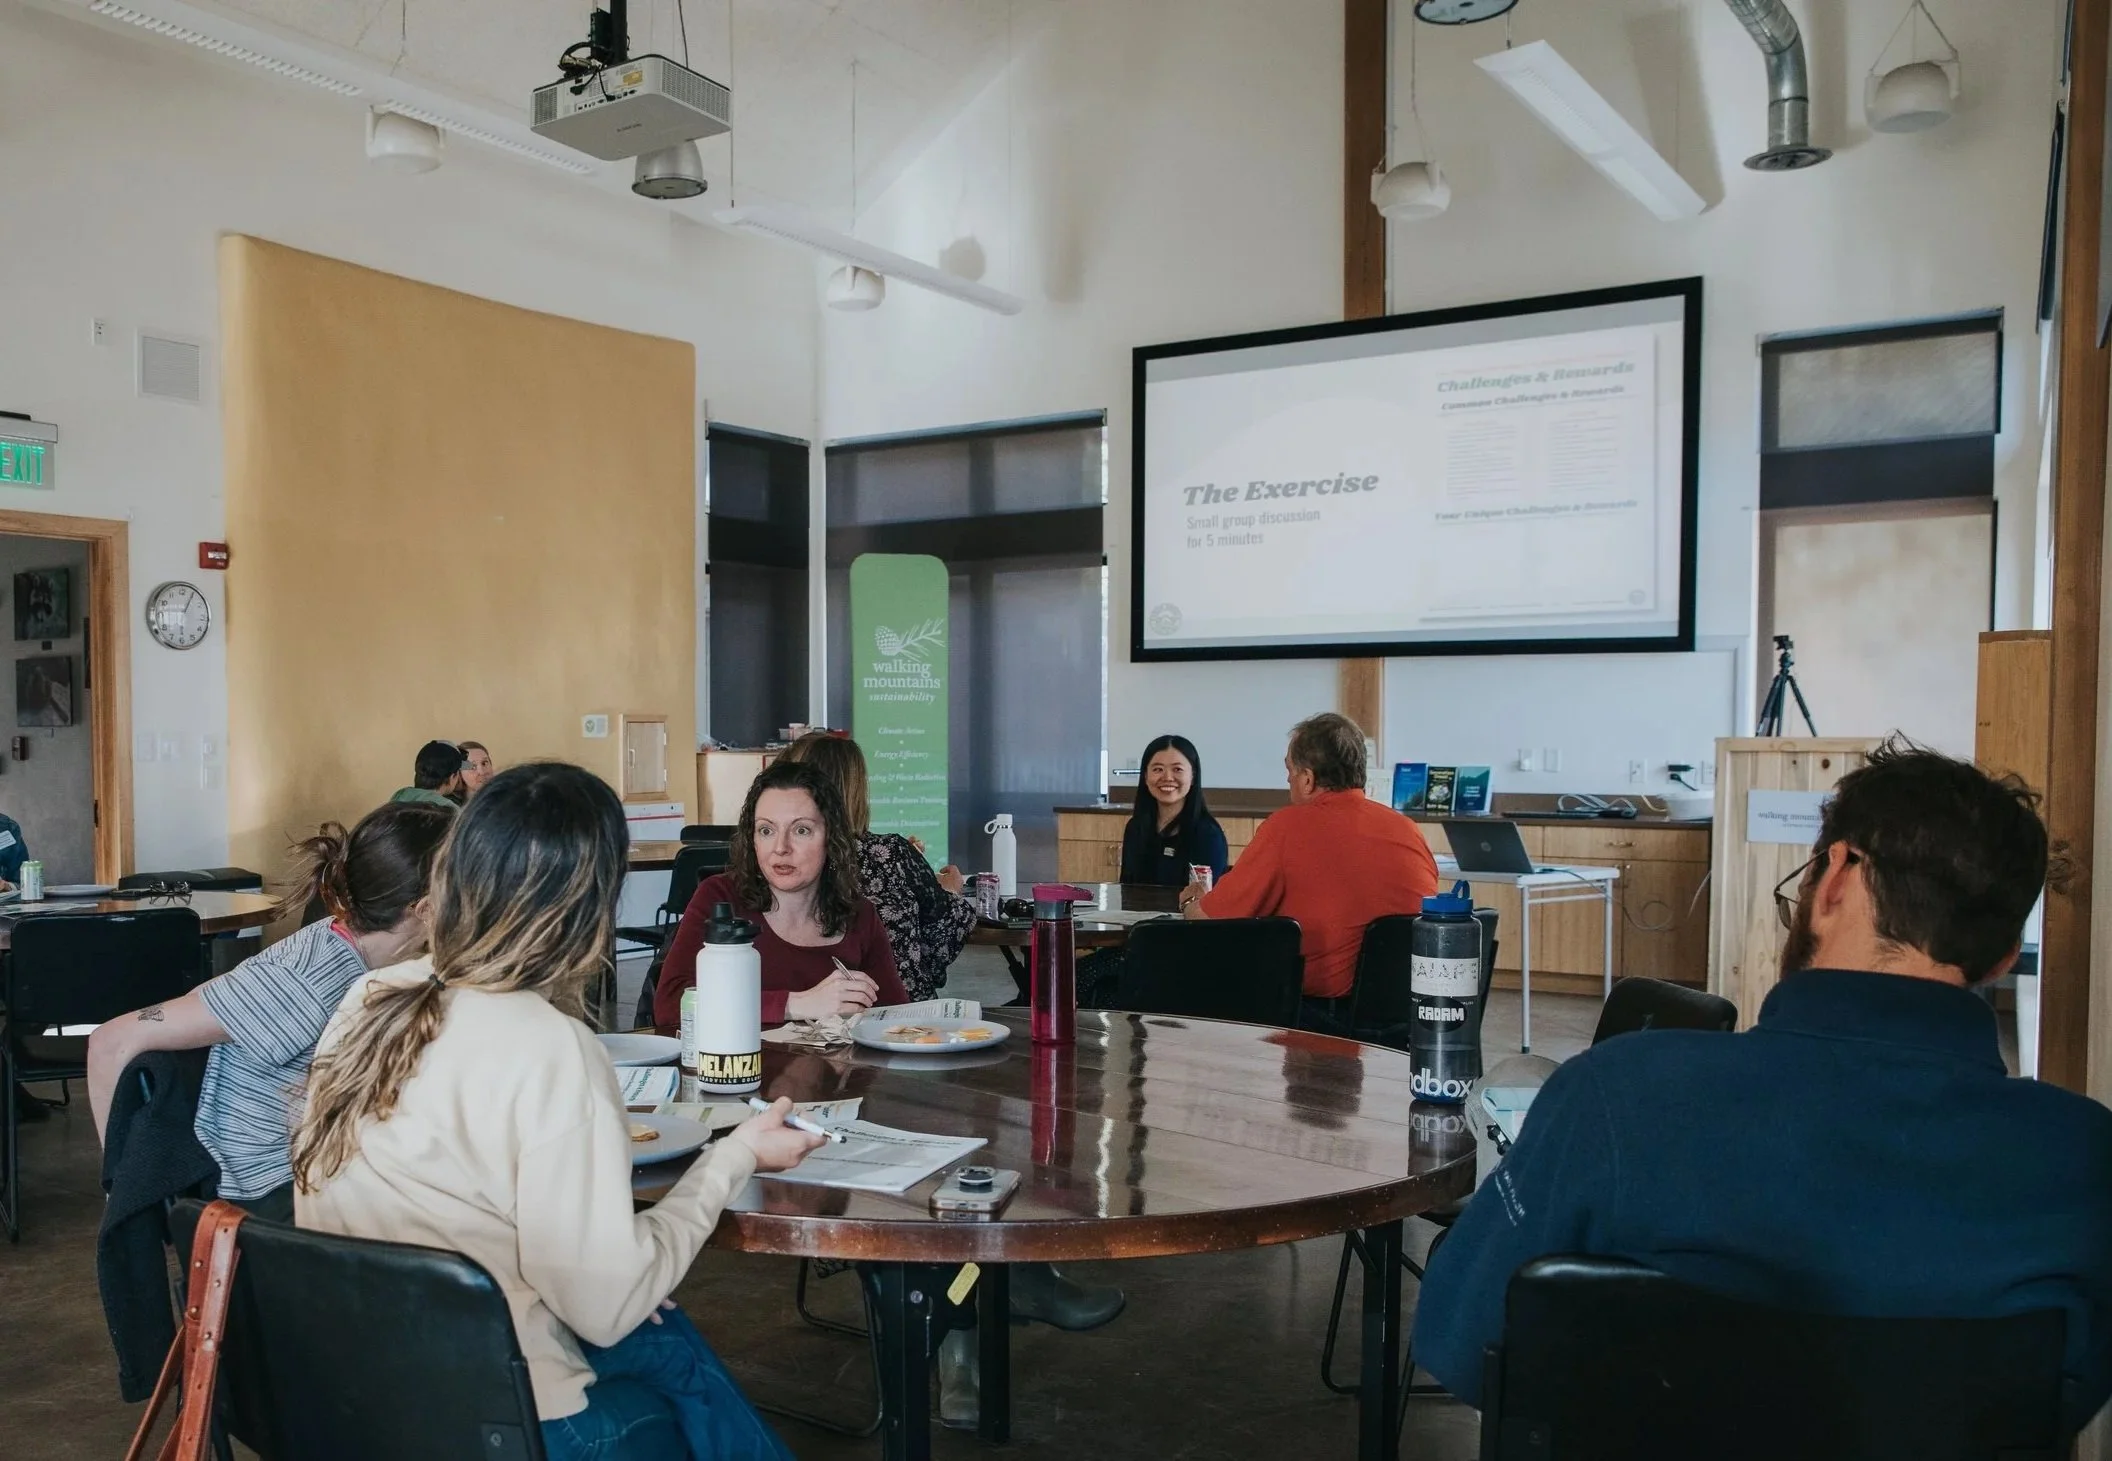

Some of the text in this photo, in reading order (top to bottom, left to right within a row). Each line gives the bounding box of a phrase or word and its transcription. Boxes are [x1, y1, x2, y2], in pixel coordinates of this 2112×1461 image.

[1437, 361, 1635, 393] Challenges & Rewards
[0, 441, 45, 486] EXIT
[1183, 472, 1379, 506] The Exercise
[1186, 508, 1321, 530] Small group discussion
[1186, 532, 1264, 549] for 5 minutes
[872, 659, 932, 678] walking
[863, 677, 941, 689] mountains
[869, 691, 937, 705] sustainability
[1418, 1006, 1465, 1022] RADAM
